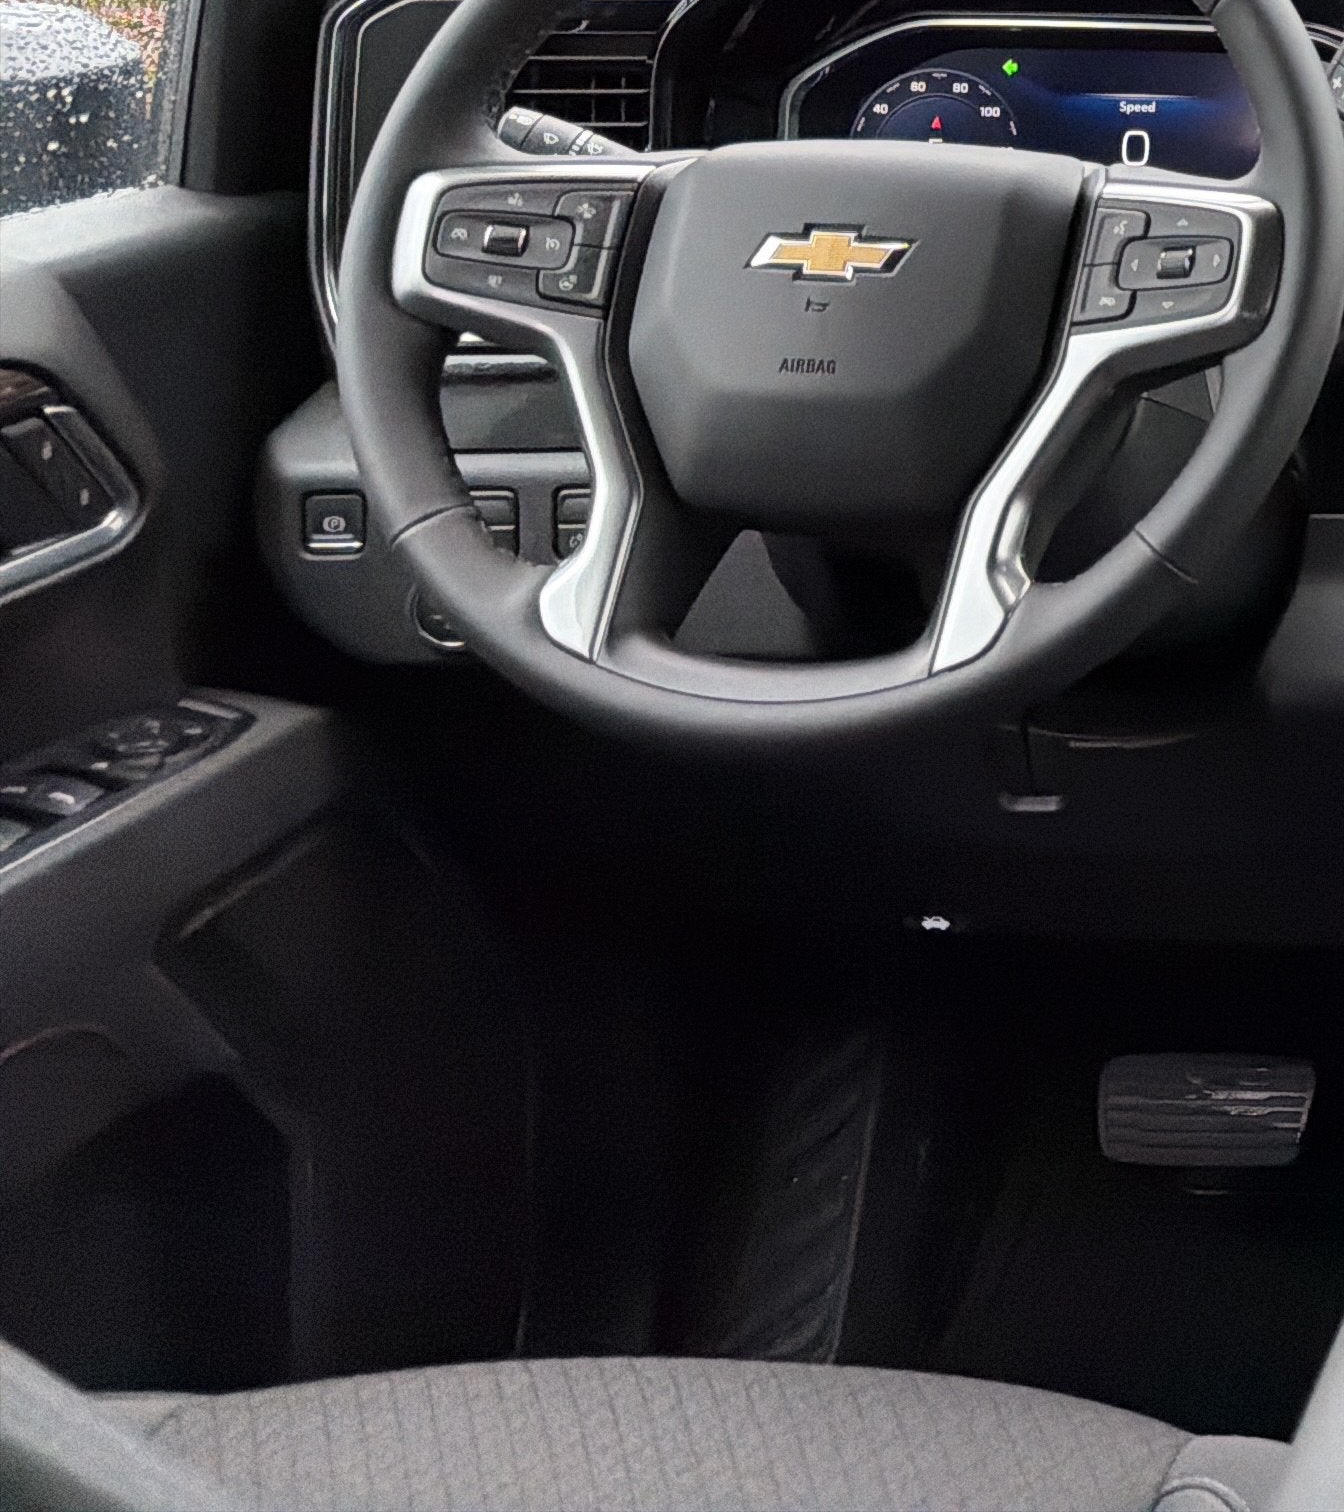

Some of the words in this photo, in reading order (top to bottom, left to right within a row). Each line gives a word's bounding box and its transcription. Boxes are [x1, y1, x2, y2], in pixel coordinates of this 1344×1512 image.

[910, 81, 926, 92] 60
[952, 82, 969, 93] 80
[872, 103, 889, 114] 40
[979, 106, 1001, 117] 100
[1119, 100, 1156, 116] Speed
[1121, 130, 1150, 166] 0
[778, 357, 836, 374] AIRBAG
